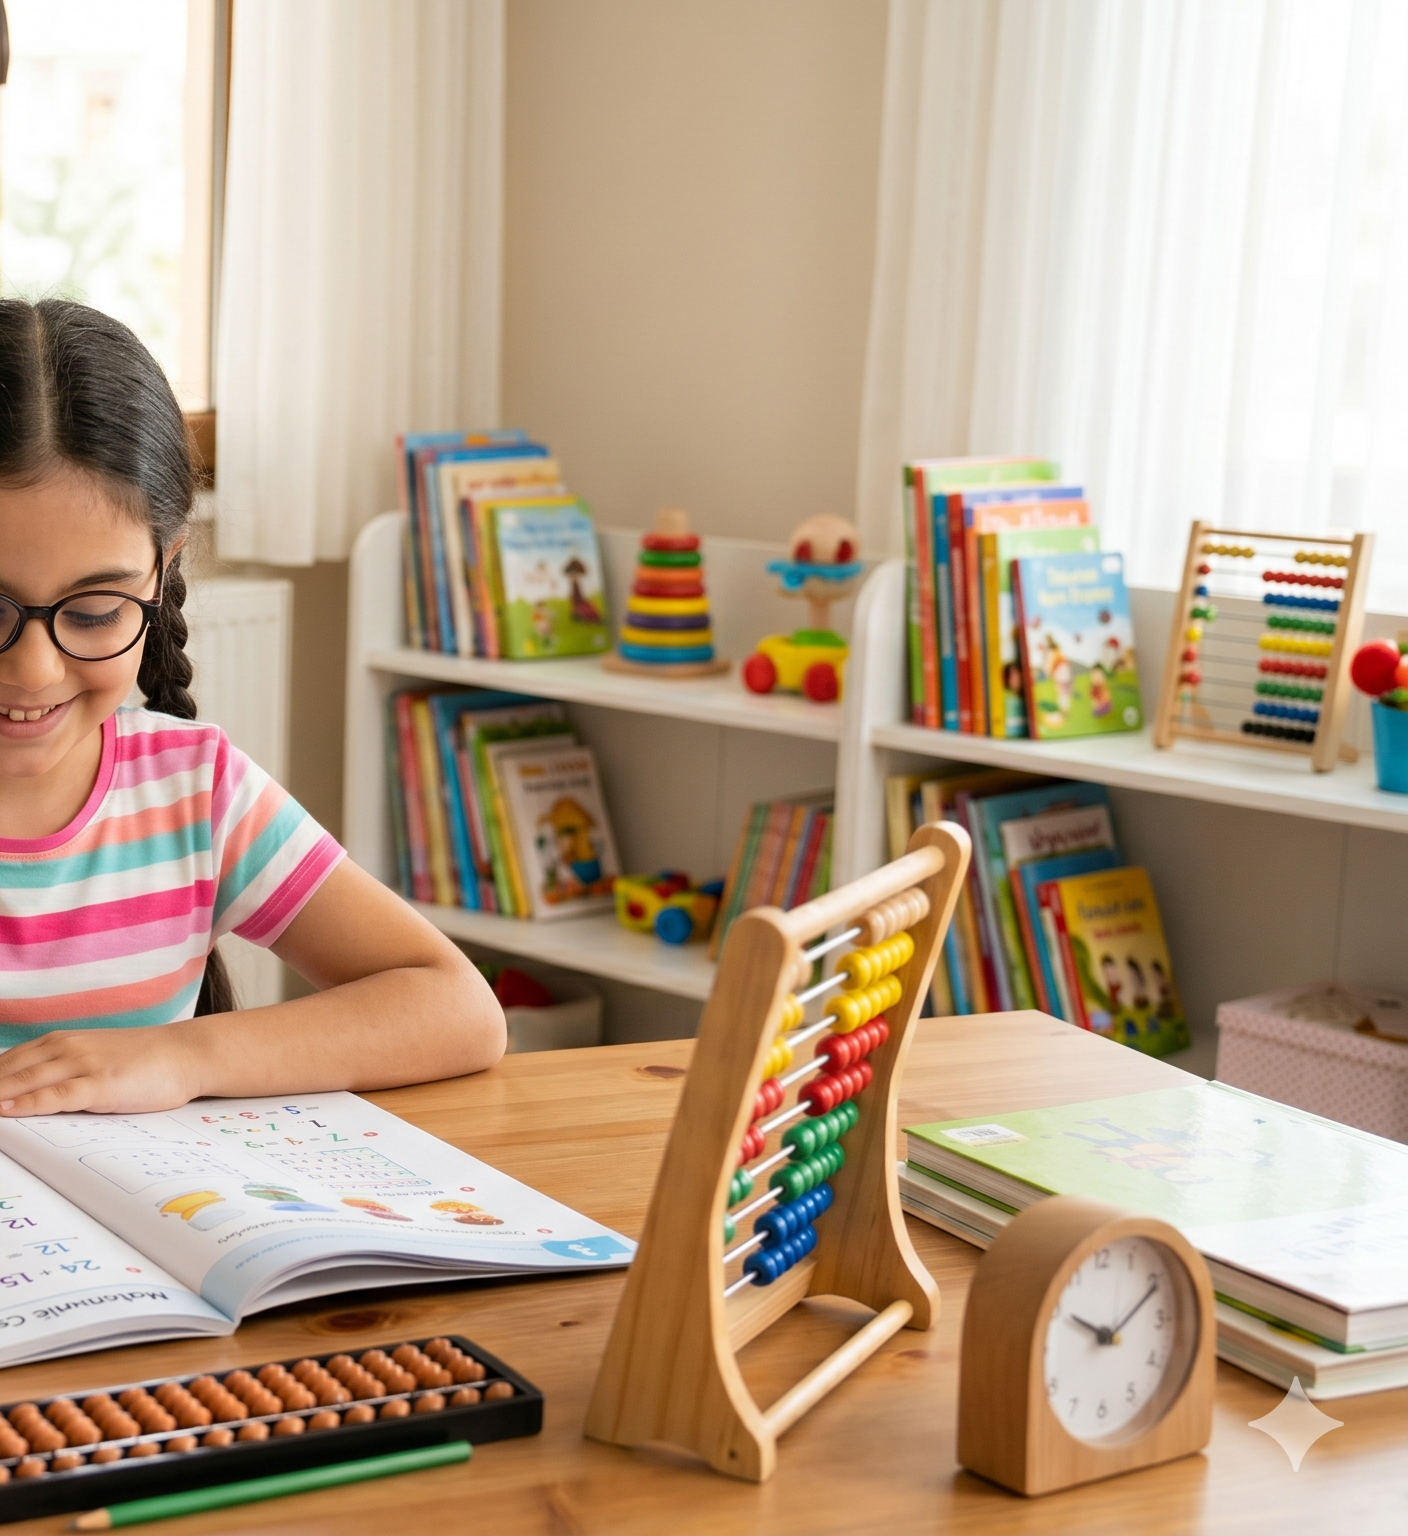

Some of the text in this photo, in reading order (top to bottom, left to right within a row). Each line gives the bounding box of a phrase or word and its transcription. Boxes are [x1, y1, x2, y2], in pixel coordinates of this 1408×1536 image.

[1, 1217, 38, 1230] 12
[34, 1242, 71, 1256] 12
[59, 1259, 101, 1274] 24
[1094, 1247, 1110, 1271] 12
[0, 1272, 34, 1288] 15
[1154, 1308, 1164, 1330] 3
[1126, 1381, 1135, 1404] 5
[1097, 1400, 1107, 1419] 6
